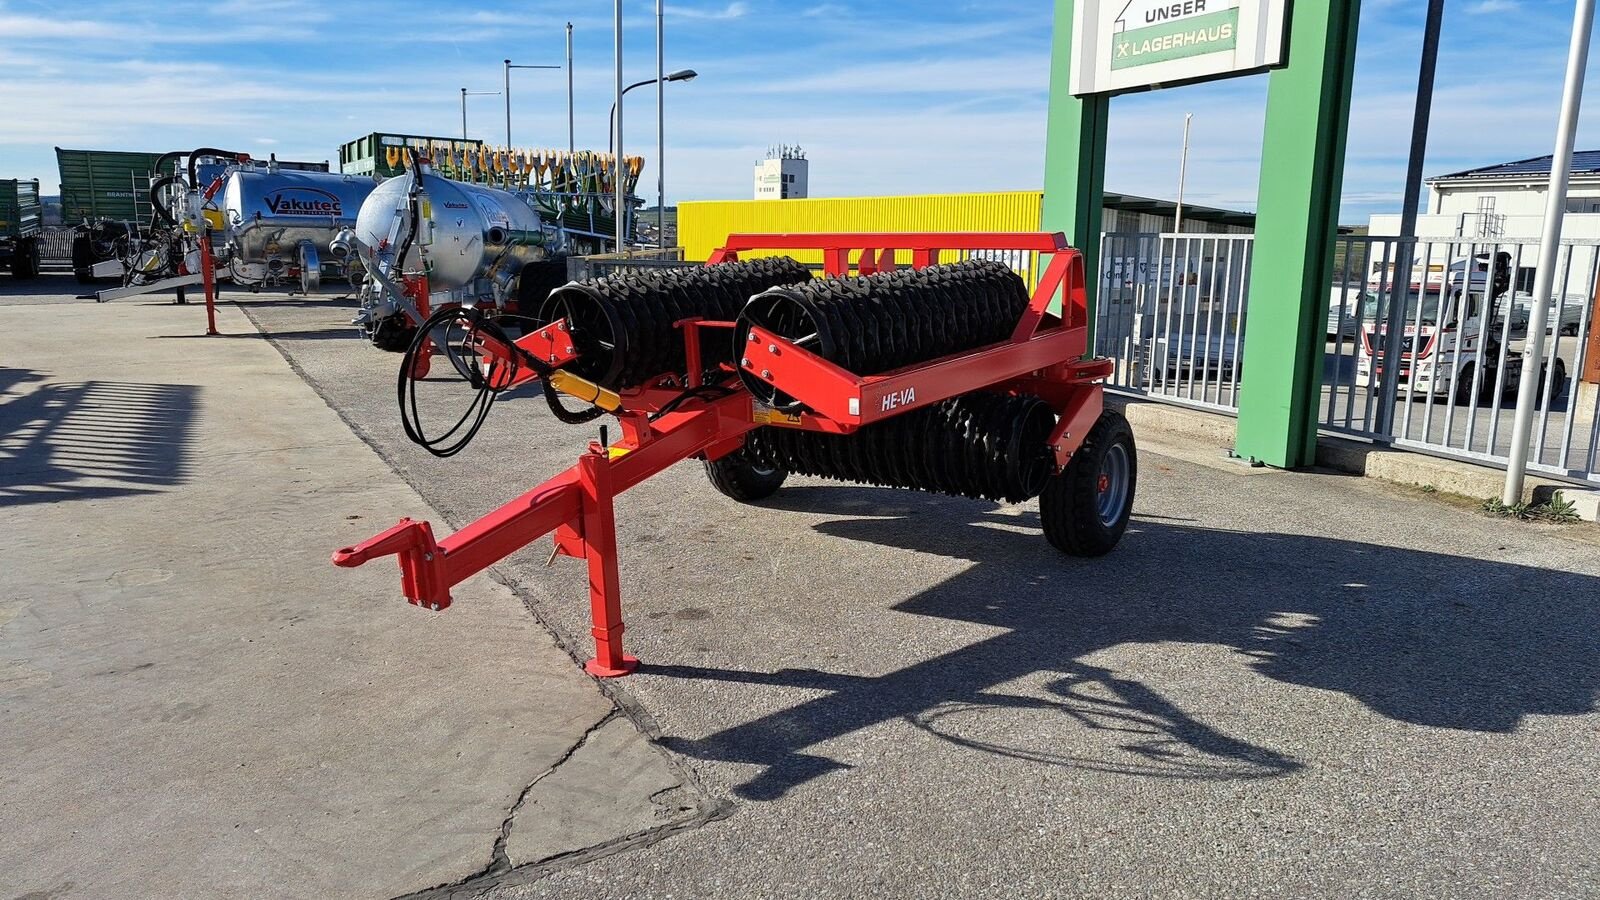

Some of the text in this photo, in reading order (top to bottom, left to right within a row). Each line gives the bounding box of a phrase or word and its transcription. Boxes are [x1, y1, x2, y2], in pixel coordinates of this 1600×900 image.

[1145, 0, 1206, 23] UNSER
[1132, 23, 1233, 56] LAGERHAUS
[263, 194, 342, 214] Vakutec
[881, 386, 916, 413] HE-VA
